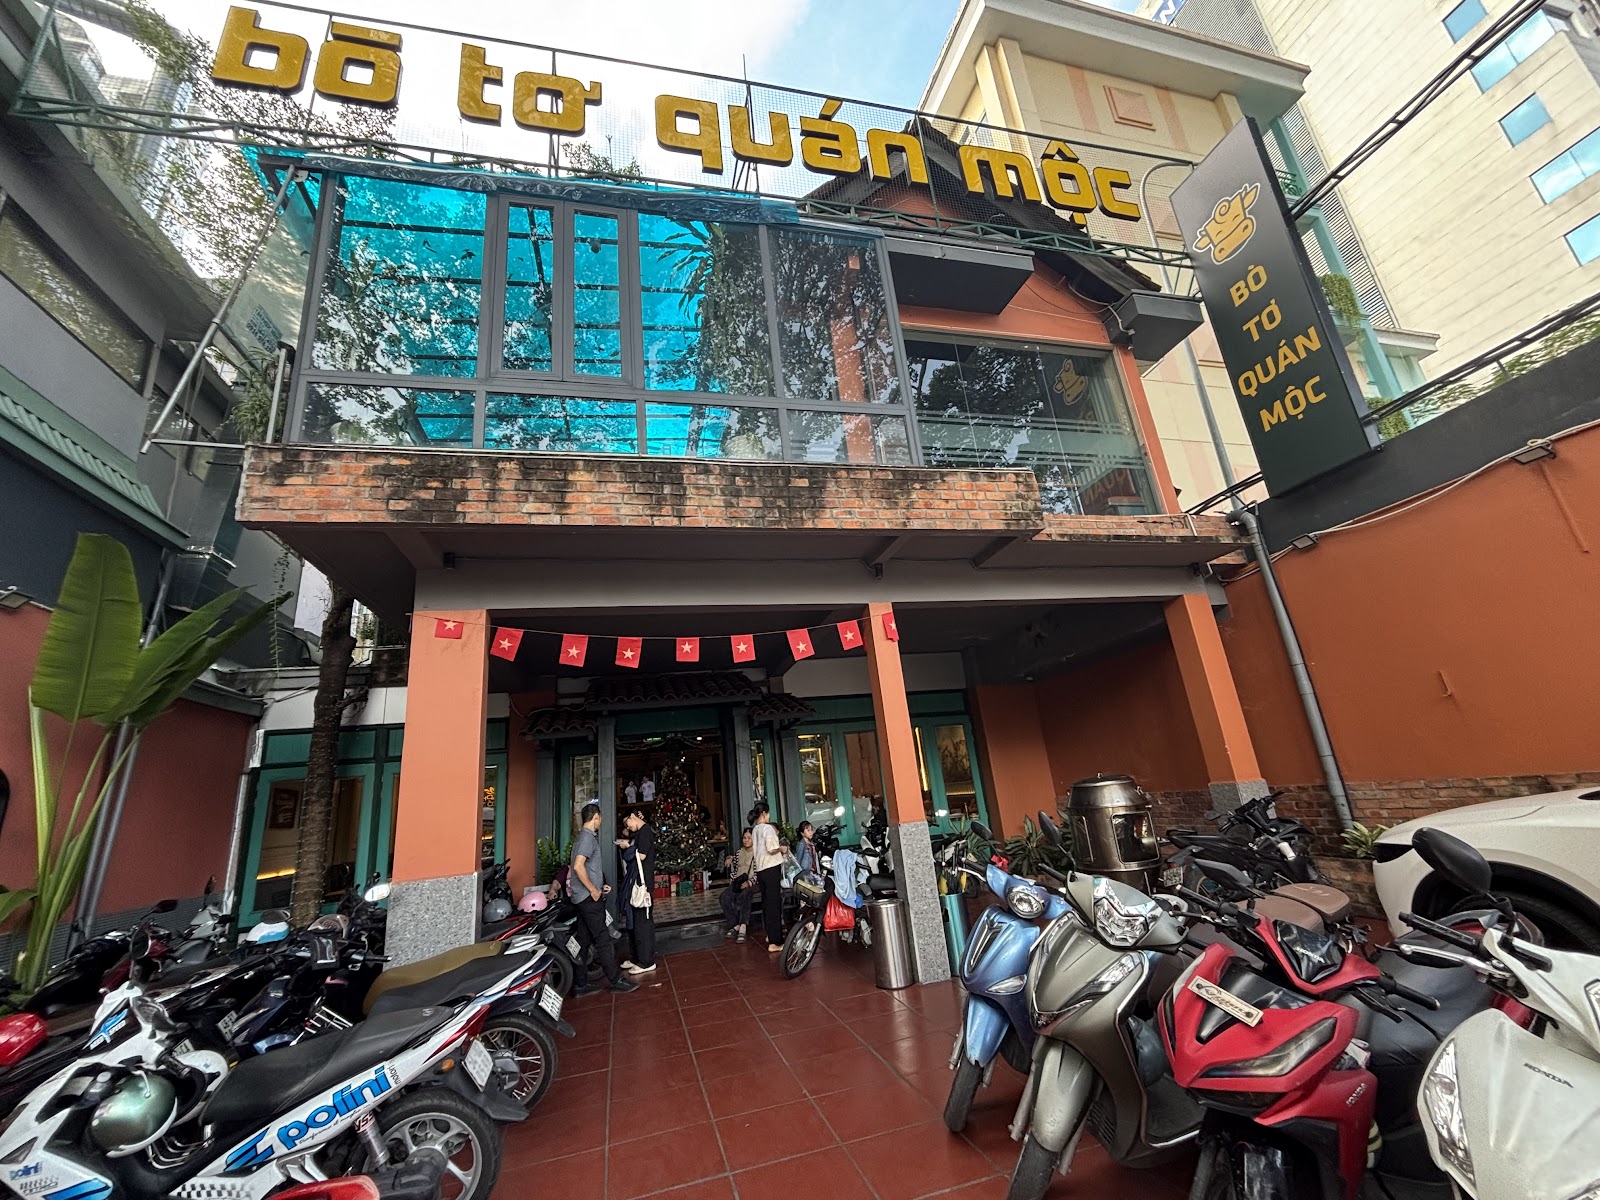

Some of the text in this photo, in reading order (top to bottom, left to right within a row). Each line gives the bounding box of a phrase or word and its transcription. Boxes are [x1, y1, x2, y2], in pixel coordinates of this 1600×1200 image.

[457, 43, 603, 136] tơ
[655, 94, 930, 187] quán
[958, 139, 1143, 226] mộc
[1229, 264, 1268, 308] BÒ
[1243, 298, 1283, 342] TƠ
[1237, 326, 1322, 397] QUÁN
[1259, 375, 1327, 432] MỘC
[1523, 1062, 1574, 1089] HONDA
[277, 1065, 392, 1150] polini
